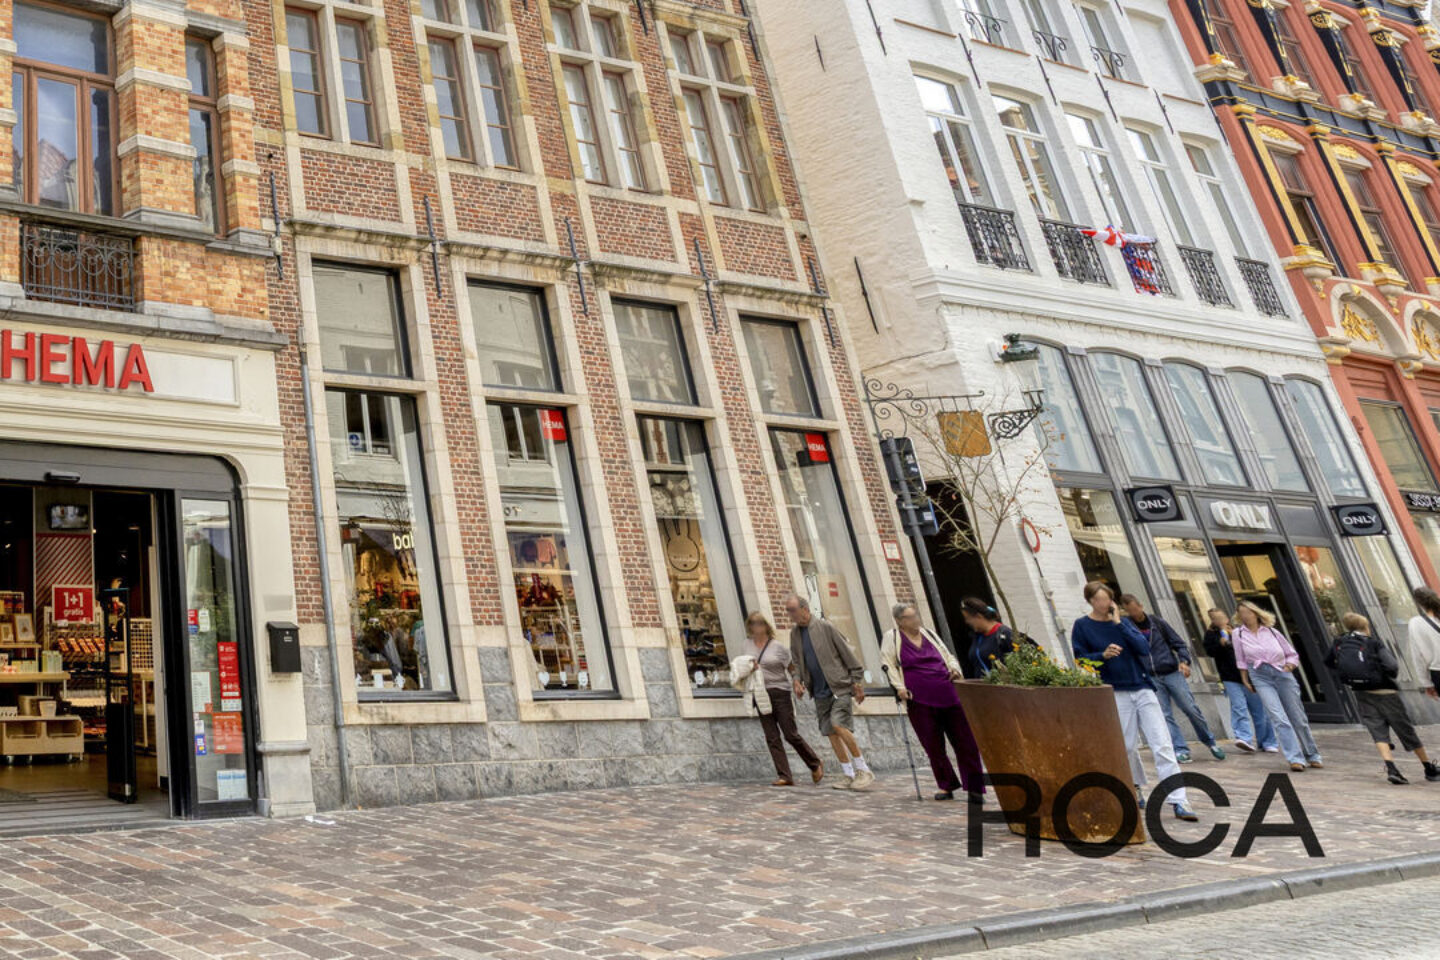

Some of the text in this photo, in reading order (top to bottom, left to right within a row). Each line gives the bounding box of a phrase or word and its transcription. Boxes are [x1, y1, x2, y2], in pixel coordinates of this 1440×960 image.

[1, 329, 154, 392] HEMA
[543, 421, 564, 429] HEMA
[808, 443, 825, 451] HEMA
[1137, 498, 1171, 509] ONLY
[1210, 501, 1272, 529] ONLY
[1342, 515, 1376, 525] ONLY
[64, 592, 84, 608] 1+1
[64, 608, 84, 617] gratis
